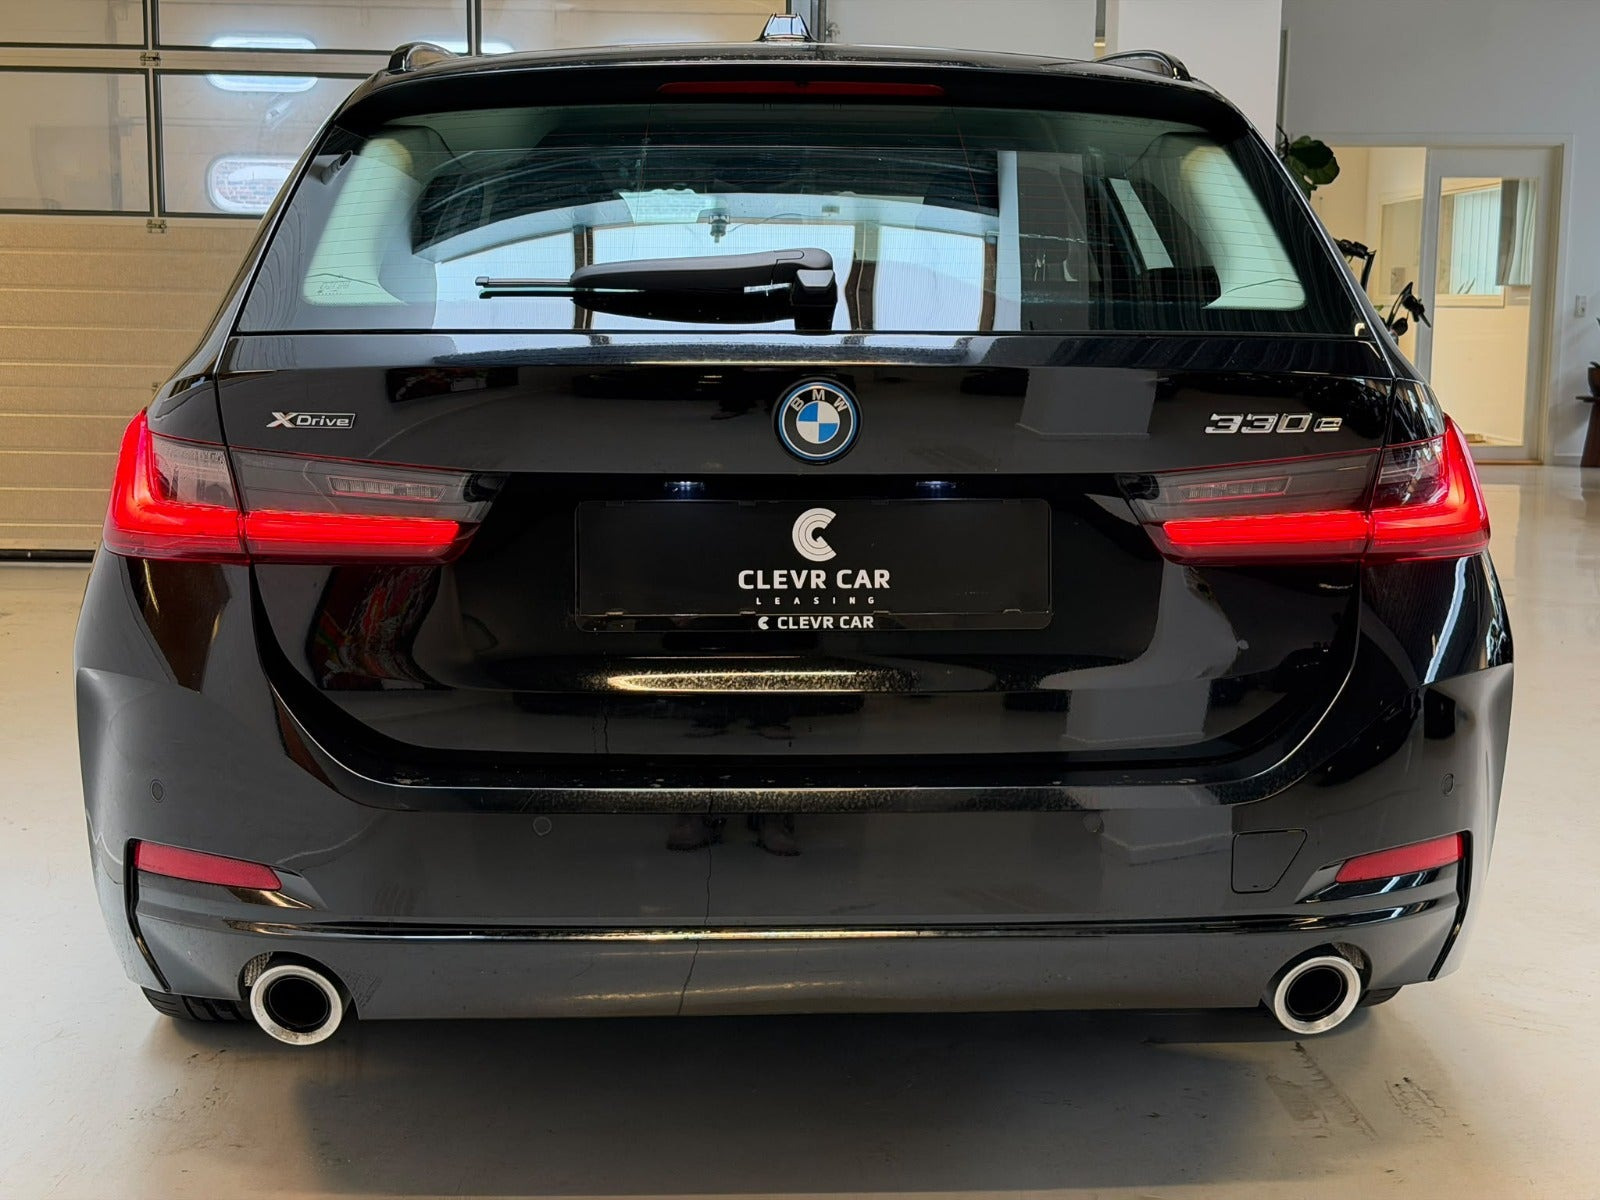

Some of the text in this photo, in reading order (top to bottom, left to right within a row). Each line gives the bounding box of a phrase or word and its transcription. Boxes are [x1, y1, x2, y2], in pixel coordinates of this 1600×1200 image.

[790, 389, 848, 412] BMW
[1204, 413, 1343, 434] 330e
[738, 569, 891, 590] CLEVR CAR
[755, 596, 875, 605] LEASING
[777, 616, 834, 630] CLEVR
[839, 615, 874, 629] CAR
